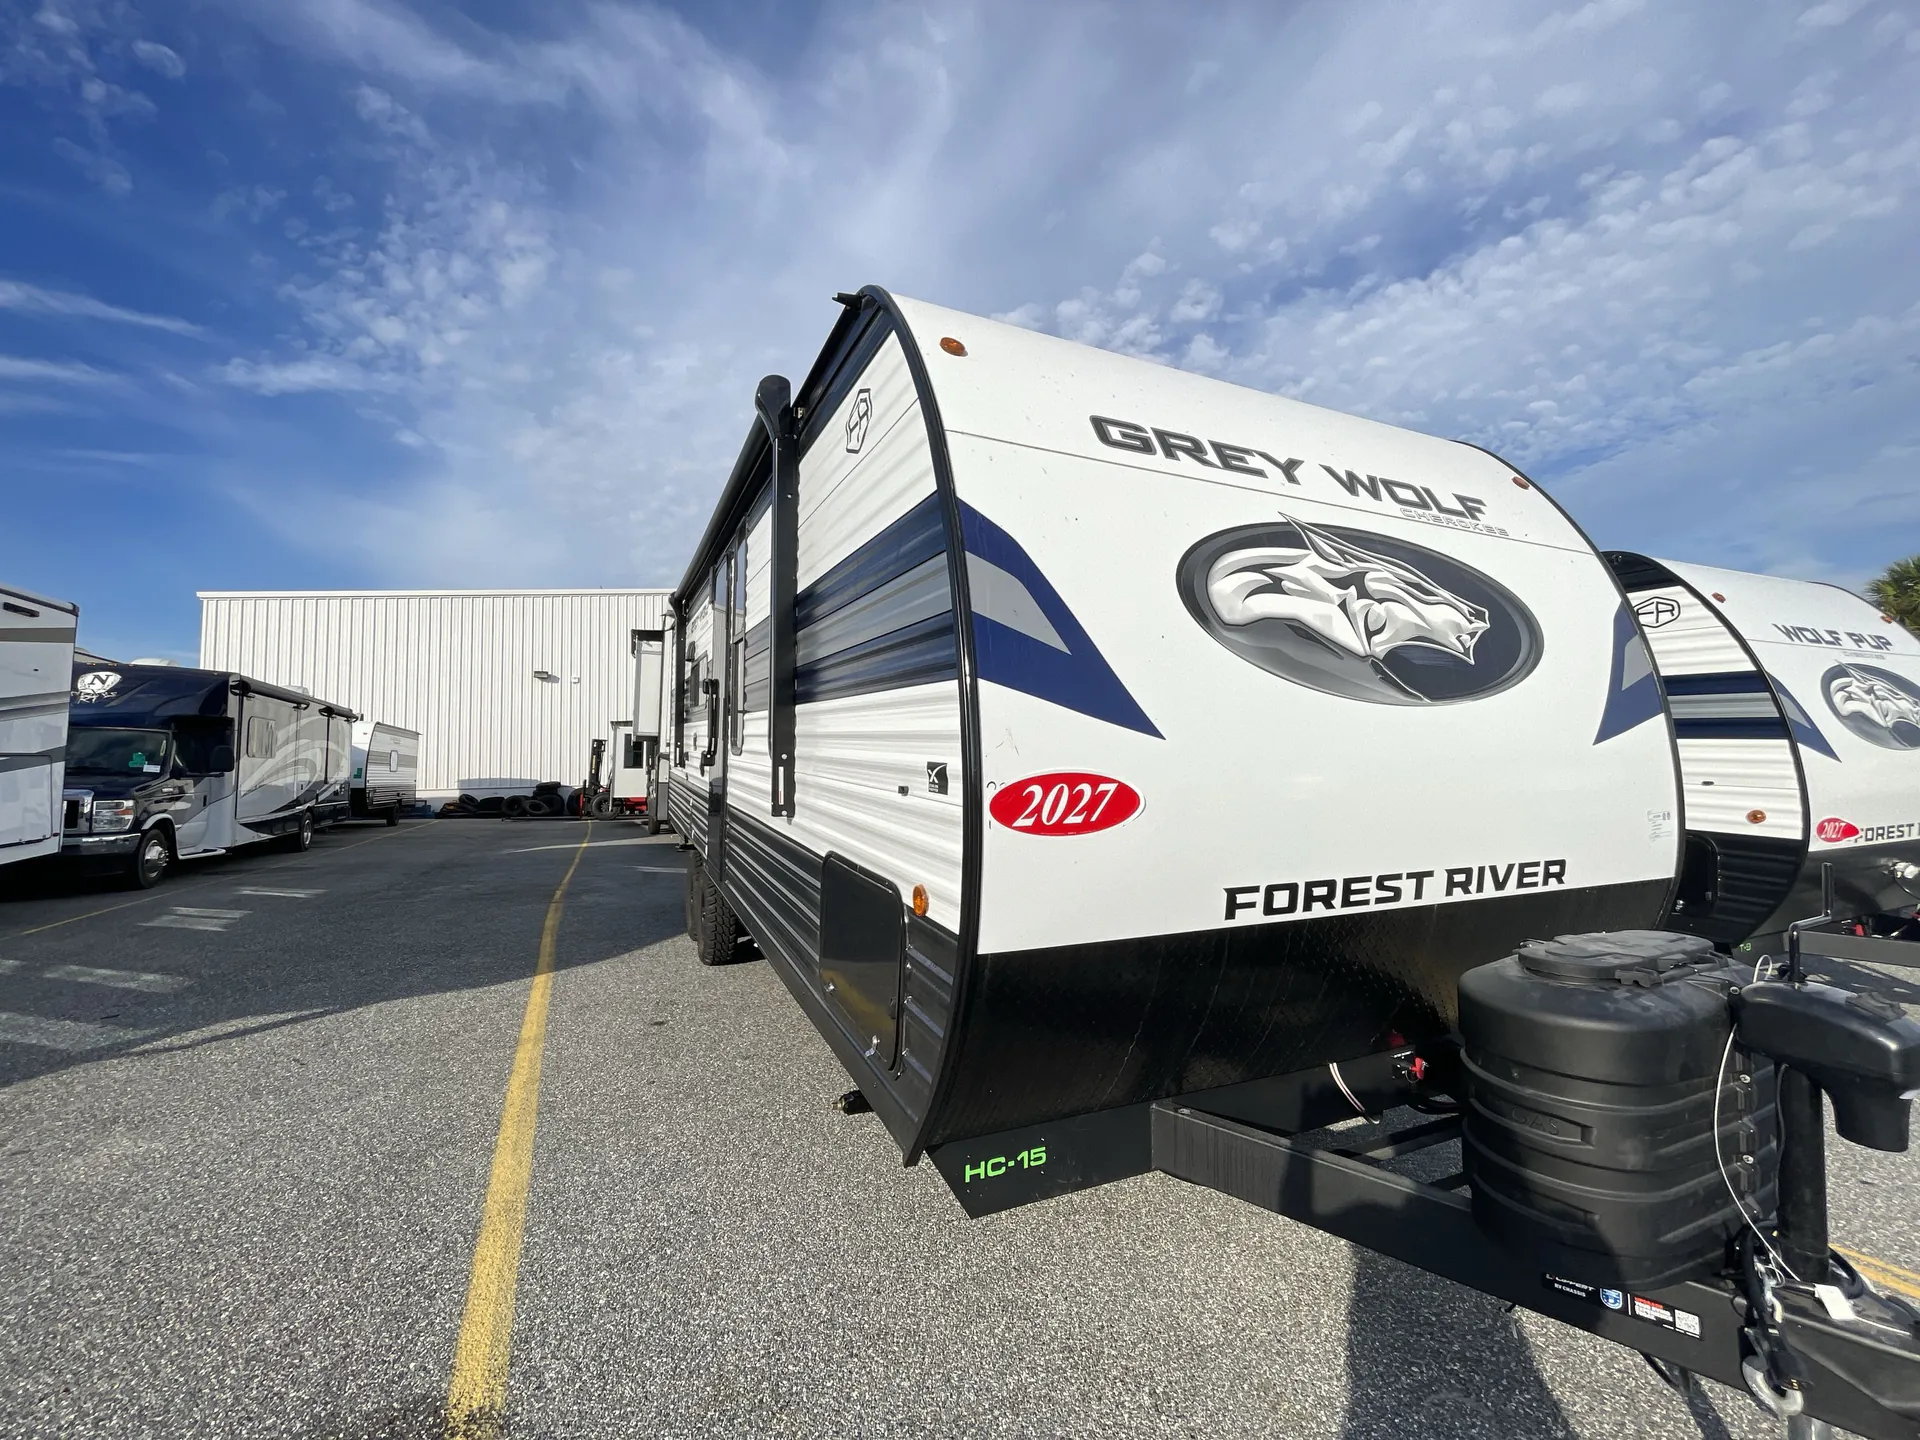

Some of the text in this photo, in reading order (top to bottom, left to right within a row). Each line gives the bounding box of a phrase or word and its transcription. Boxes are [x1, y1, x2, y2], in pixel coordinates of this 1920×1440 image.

[1088, 414, 1488, 522] GREY WOLF
[1400, 507, 1510, 537] CHEROKEE
[1771, 622, 1894, 651] WOLF PUP
[1011, 782, 1119, 828] 2027
[1820, 821, 1847, 839] 2027
[1222, 858, 1567, 921] FOREST RIVER
[1511, 1105, 1559, 1136] GAS
[964, 1145, 1047, 1183] HC-15
